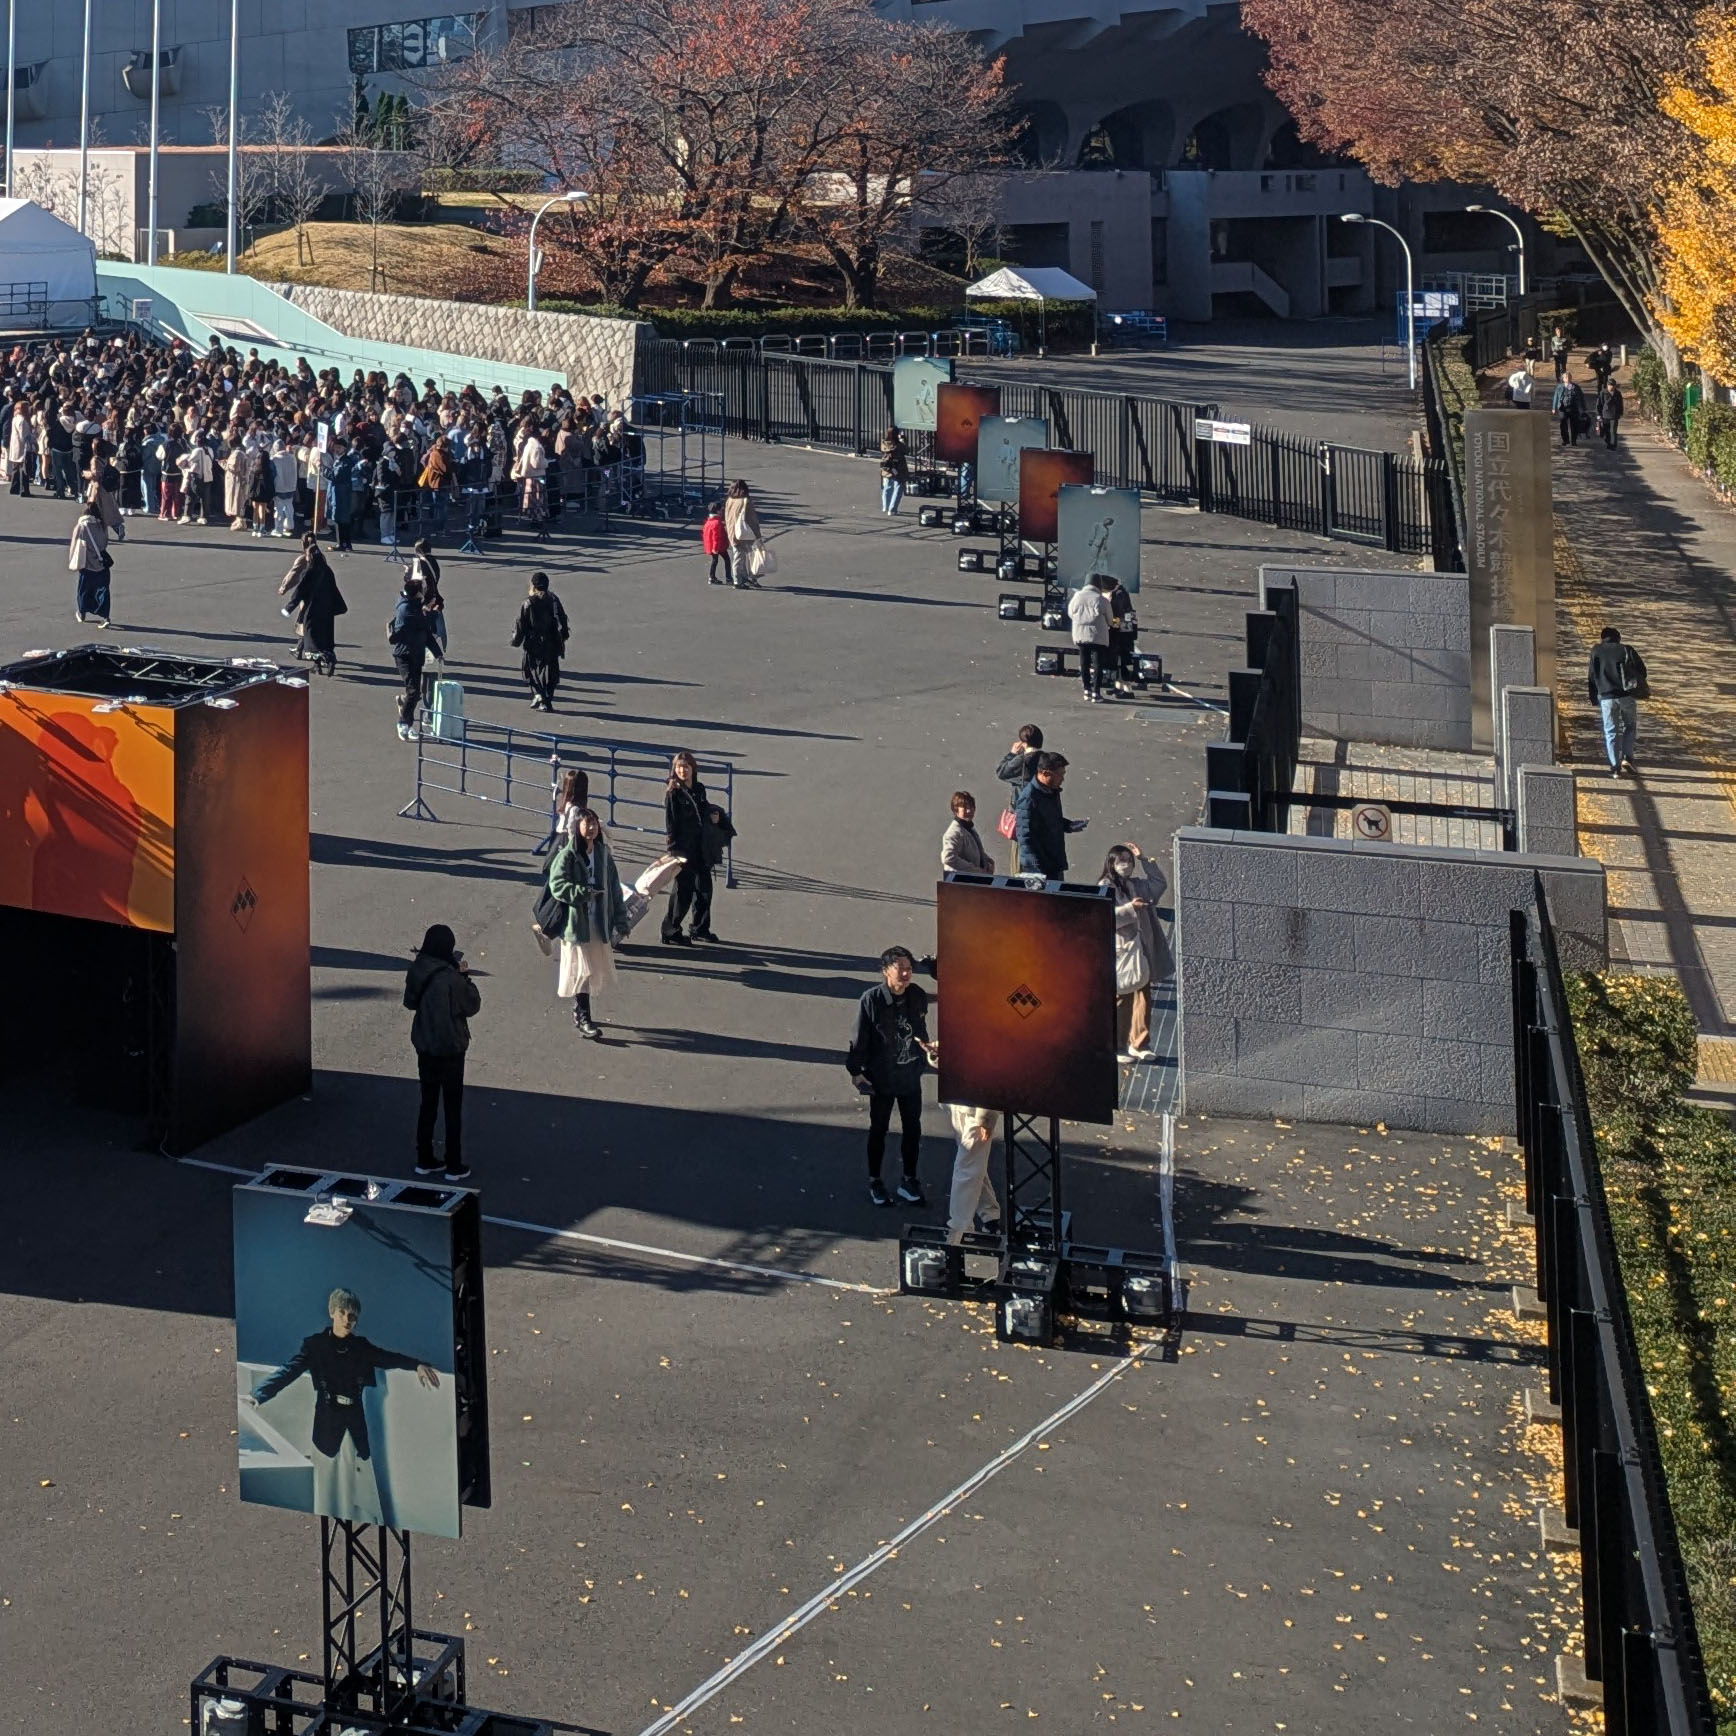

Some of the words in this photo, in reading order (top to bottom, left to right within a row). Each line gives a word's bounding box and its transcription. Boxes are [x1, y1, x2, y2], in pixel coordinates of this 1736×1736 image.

[1473, 431, 1483, 467] YOYOGI
[1474, 470, 1485, 521] NATIONAL
[1476, 523, 1486, 568] STADIUM
